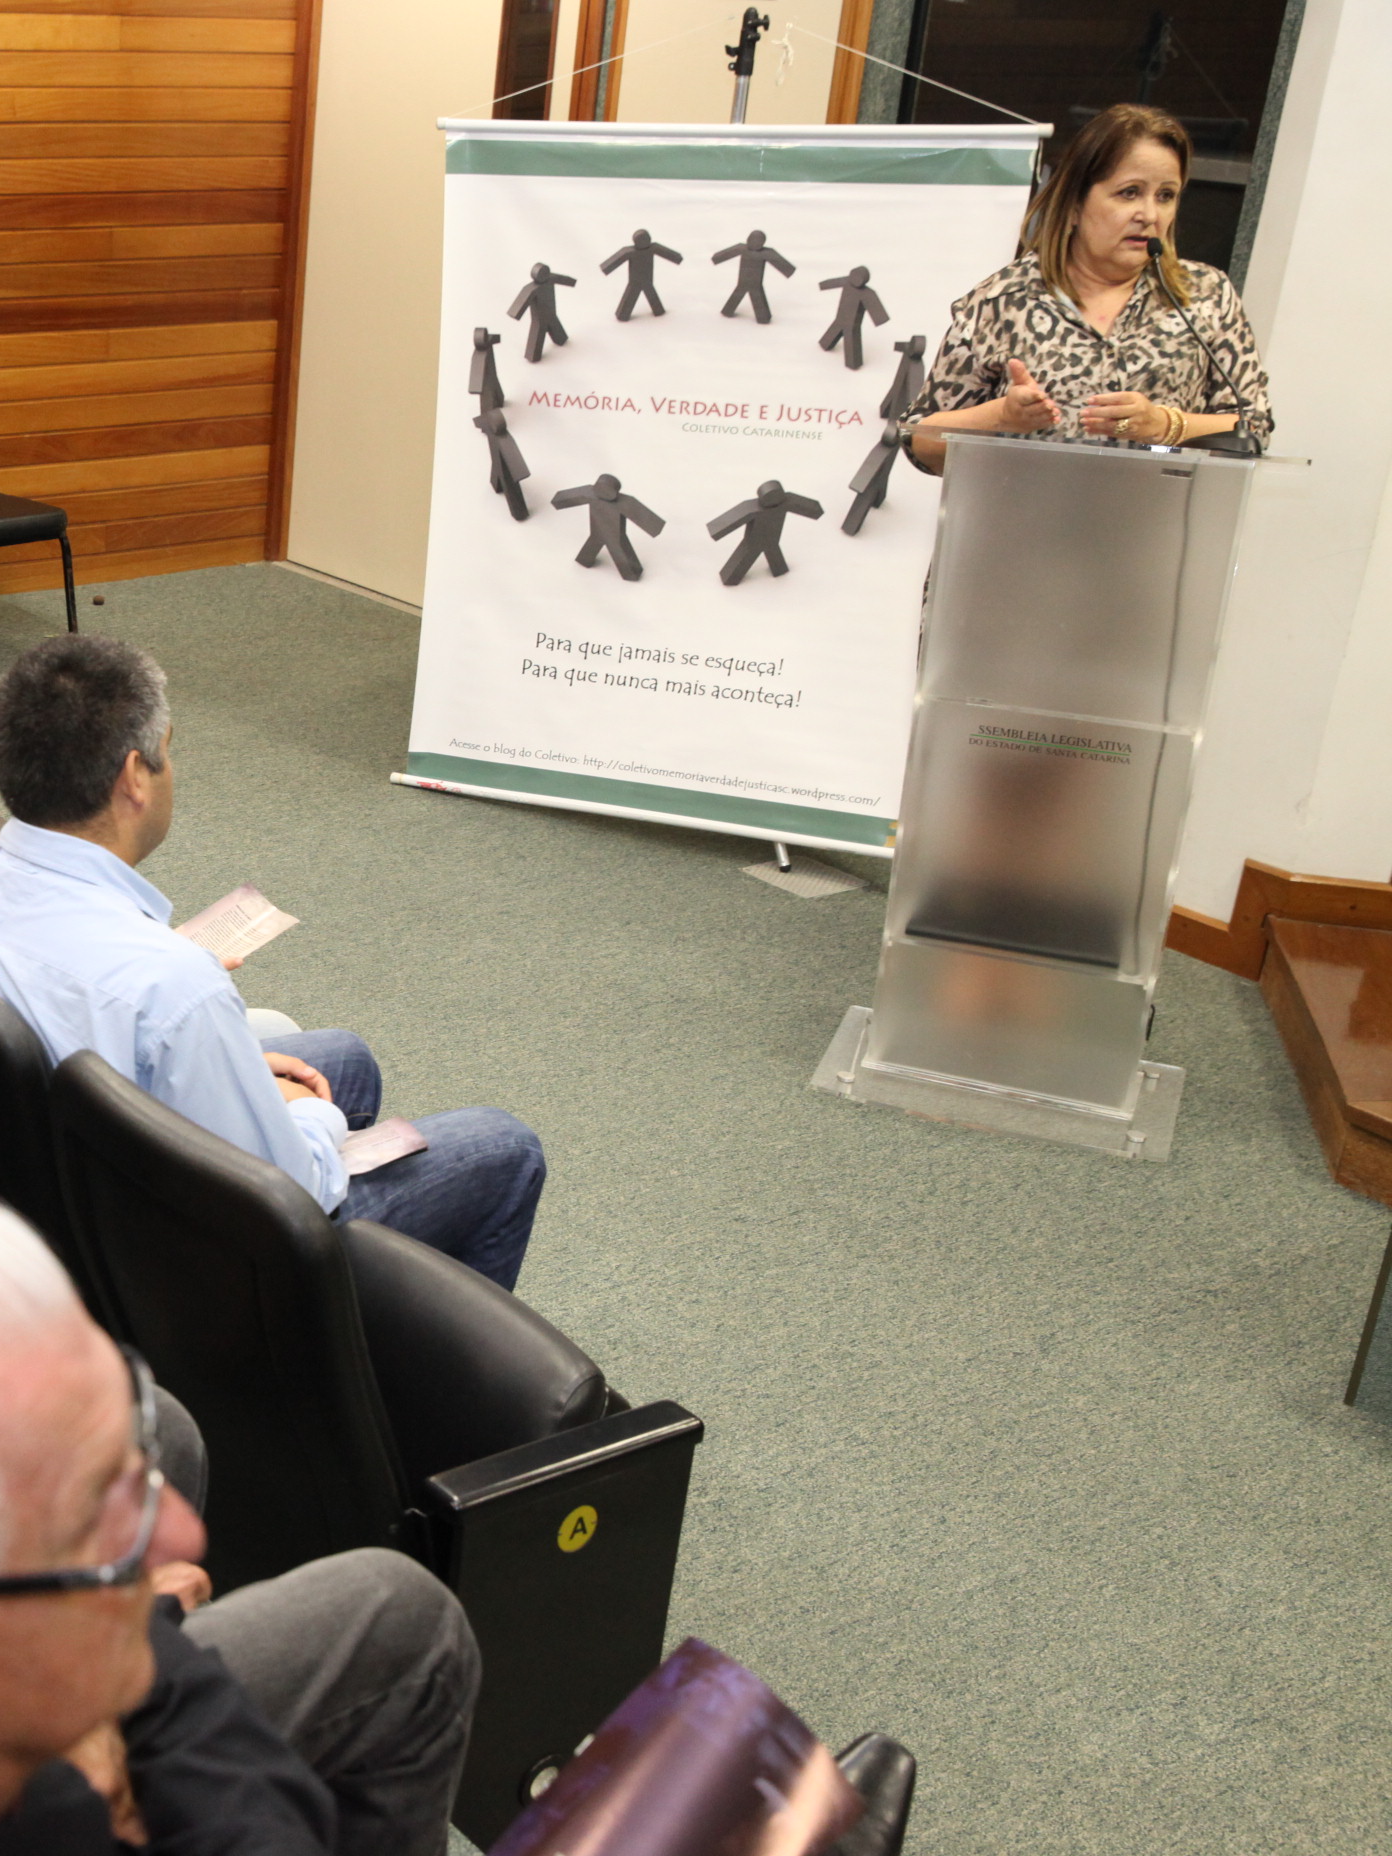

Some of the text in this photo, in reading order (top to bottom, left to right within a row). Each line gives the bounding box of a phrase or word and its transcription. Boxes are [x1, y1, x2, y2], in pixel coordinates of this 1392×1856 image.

[528, 390, 864, 429] MEMÓRIA, VERDADE E JUSTIÇA
[681, 422, 823, 441] COLETIVO CATARINENSE
[535, 632, 785, 677] Para que jamais se esqueça!
[521, 658, 802, 709] Para que nunca mais aconteça!
[448, 738, 481, 751] Acesse
[483, 744, 491, 752] o
[493, 743, 516, 758] blog
[518, 746, 532, 758] do
[969, 737, 1131, 766] DO ESTADO DE SANTA CATARINA
[1051, 733, 1132, 754] LEGISLATIVA
[569, 1516, 588, 1541] A
